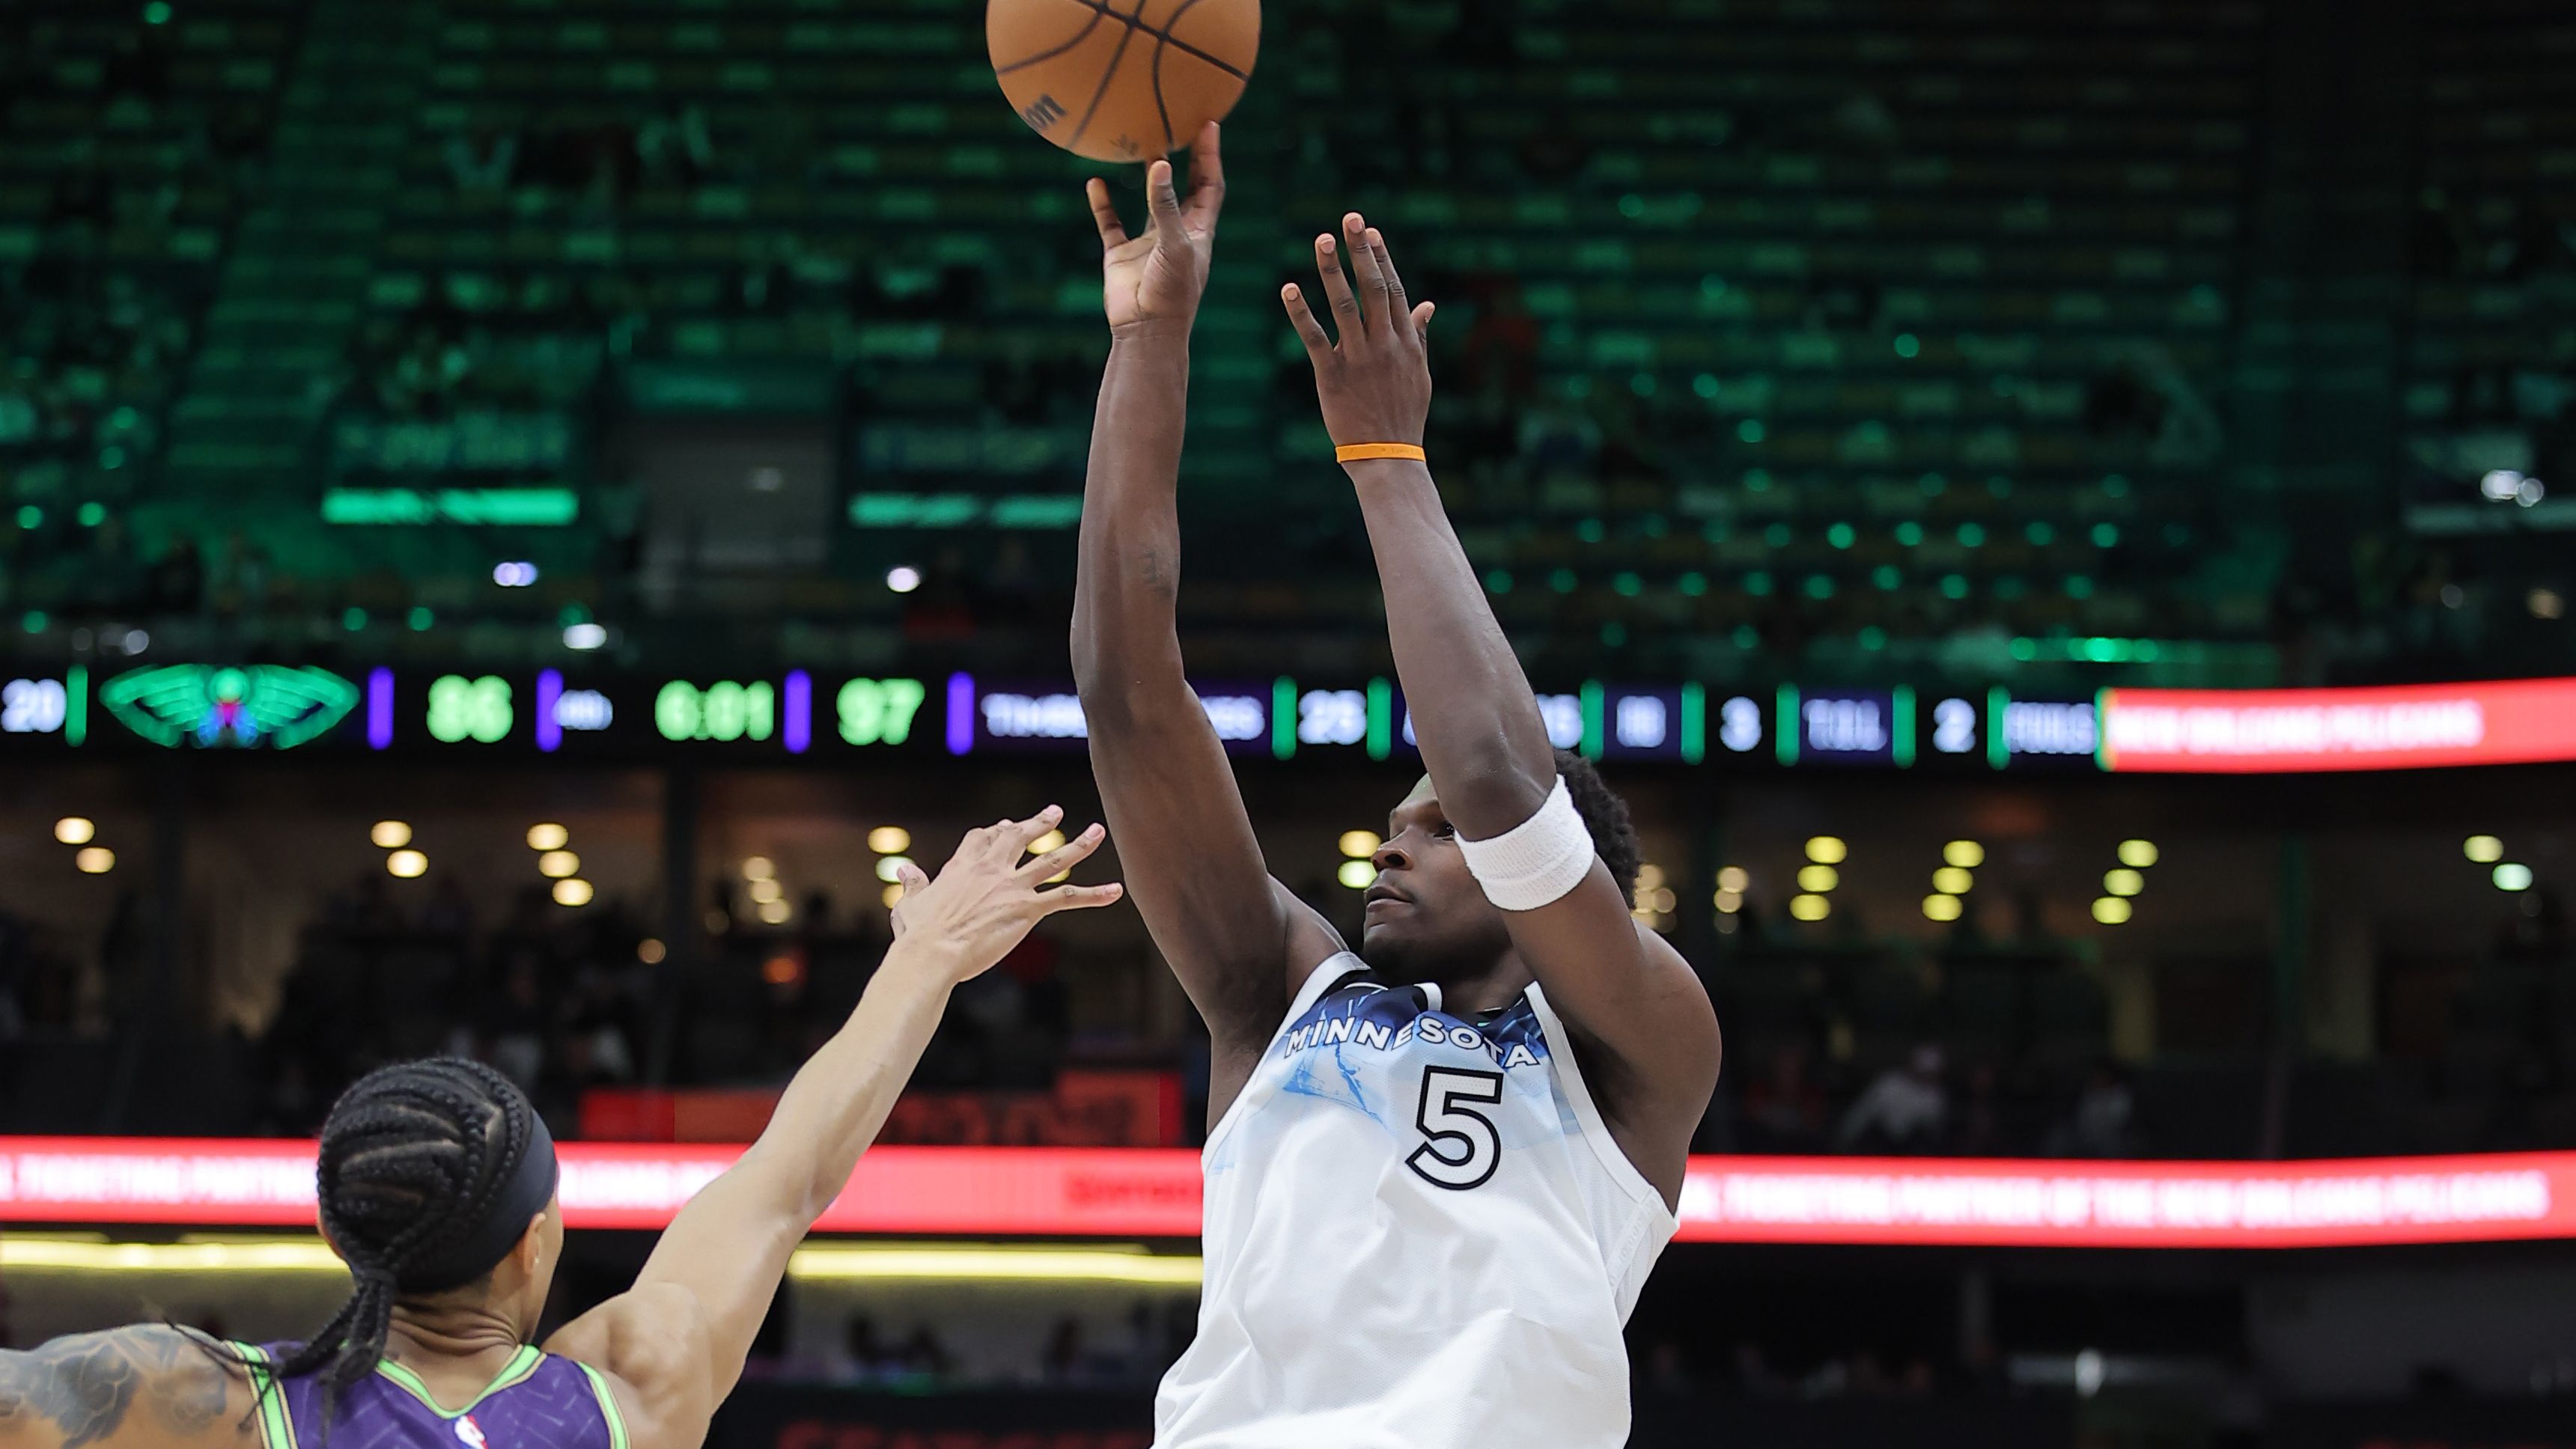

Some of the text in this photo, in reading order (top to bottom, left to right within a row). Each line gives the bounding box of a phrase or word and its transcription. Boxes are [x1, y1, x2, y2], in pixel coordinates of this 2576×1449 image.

[838, 679, 924, 745] 97
[1721, 700, 1762, 750] 3
[1934, 701, 1975, 751] 2
[1285, 1016, 1540, 1069] MINNESOTA
[1405, 1064, 1505, 1190] 5
